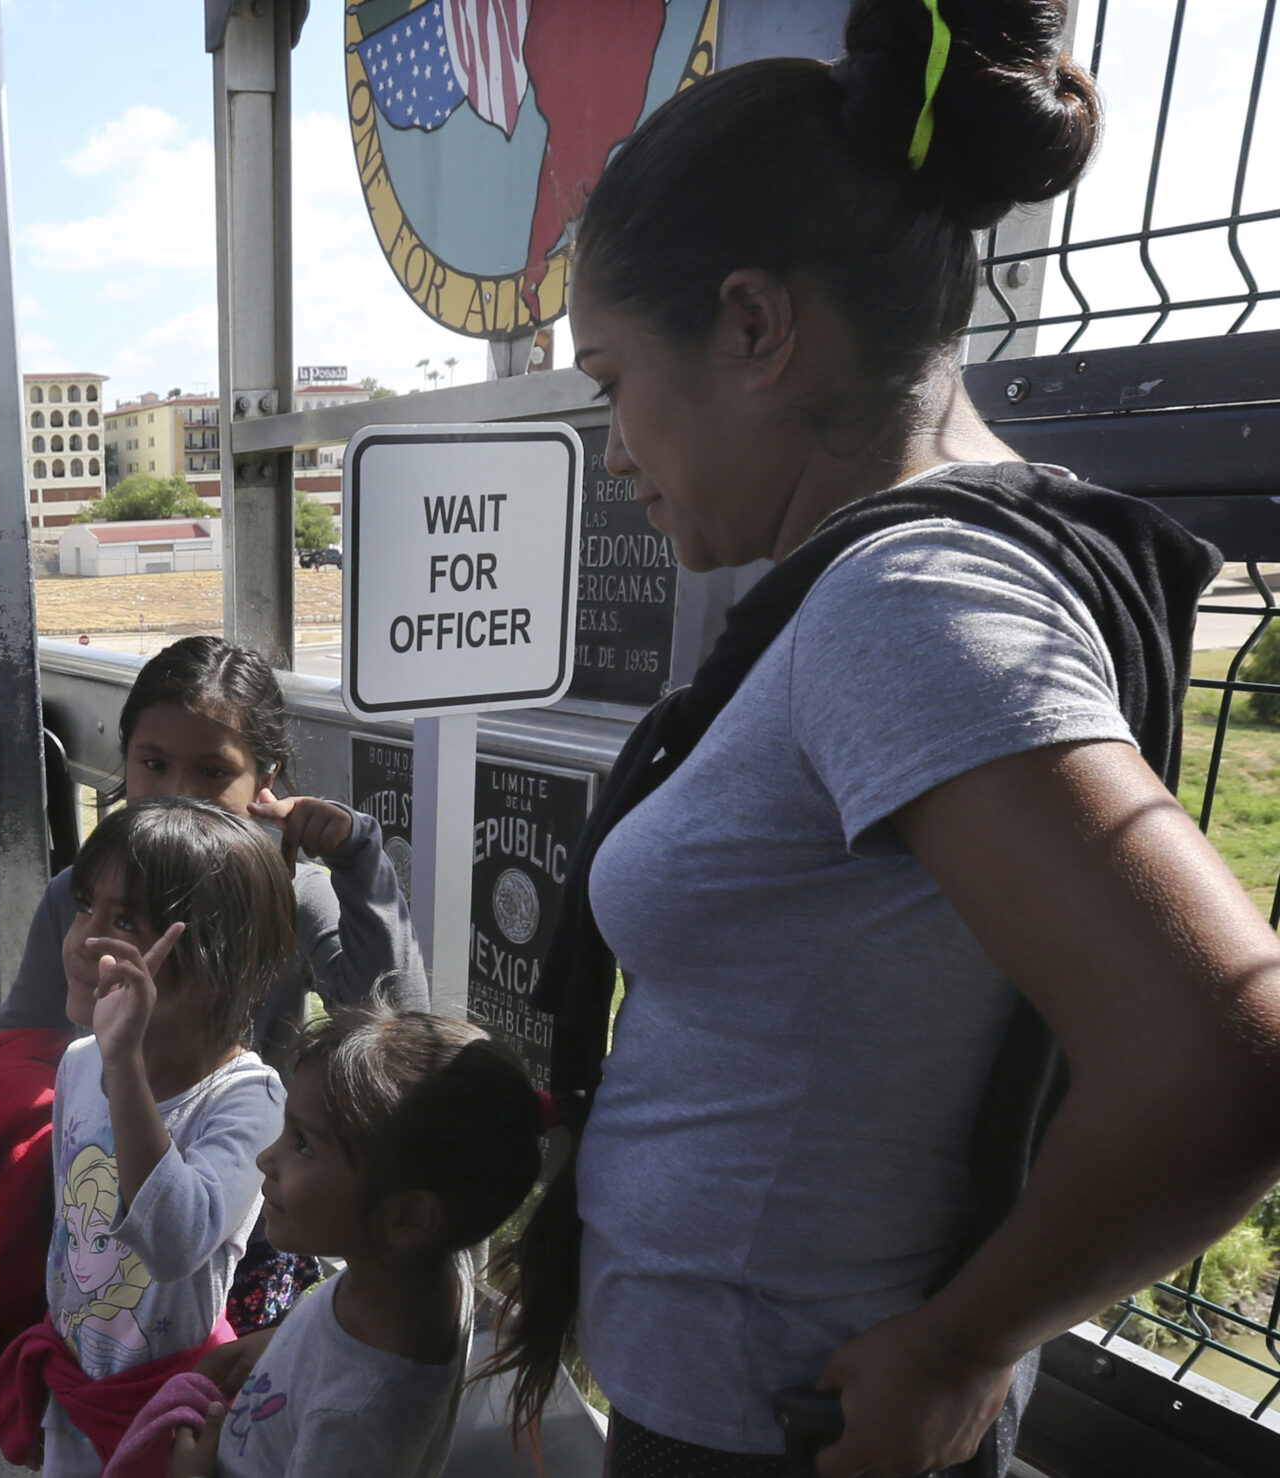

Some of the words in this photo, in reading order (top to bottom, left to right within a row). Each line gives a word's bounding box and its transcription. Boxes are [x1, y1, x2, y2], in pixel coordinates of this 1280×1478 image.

[389, 214, 448, 320] FOR
[310, 367, 347, 381] Posada
[596, 479, 638, 503] REGIO
[423, 493, 507, 535] WAIT
[585, 510, 608, 528] LAS
[429, 552, 498, 593] FOR
[577, 574, 667, 604] ERICANAS
[389, 607, 532, 654] OFFICER
[579, 609, 622, 633] EXAS.
[598, 646, 616, 669] DE
[624, 648, 659, 673] 1935
[492, 770, 548, 799] LIMITE
[505, 795, 519, 810] DE
[520, 797, 532, 812] LA
[473, 815, 568, 885] EPUBLIC
[470, 923, 540, 995] EXICA
